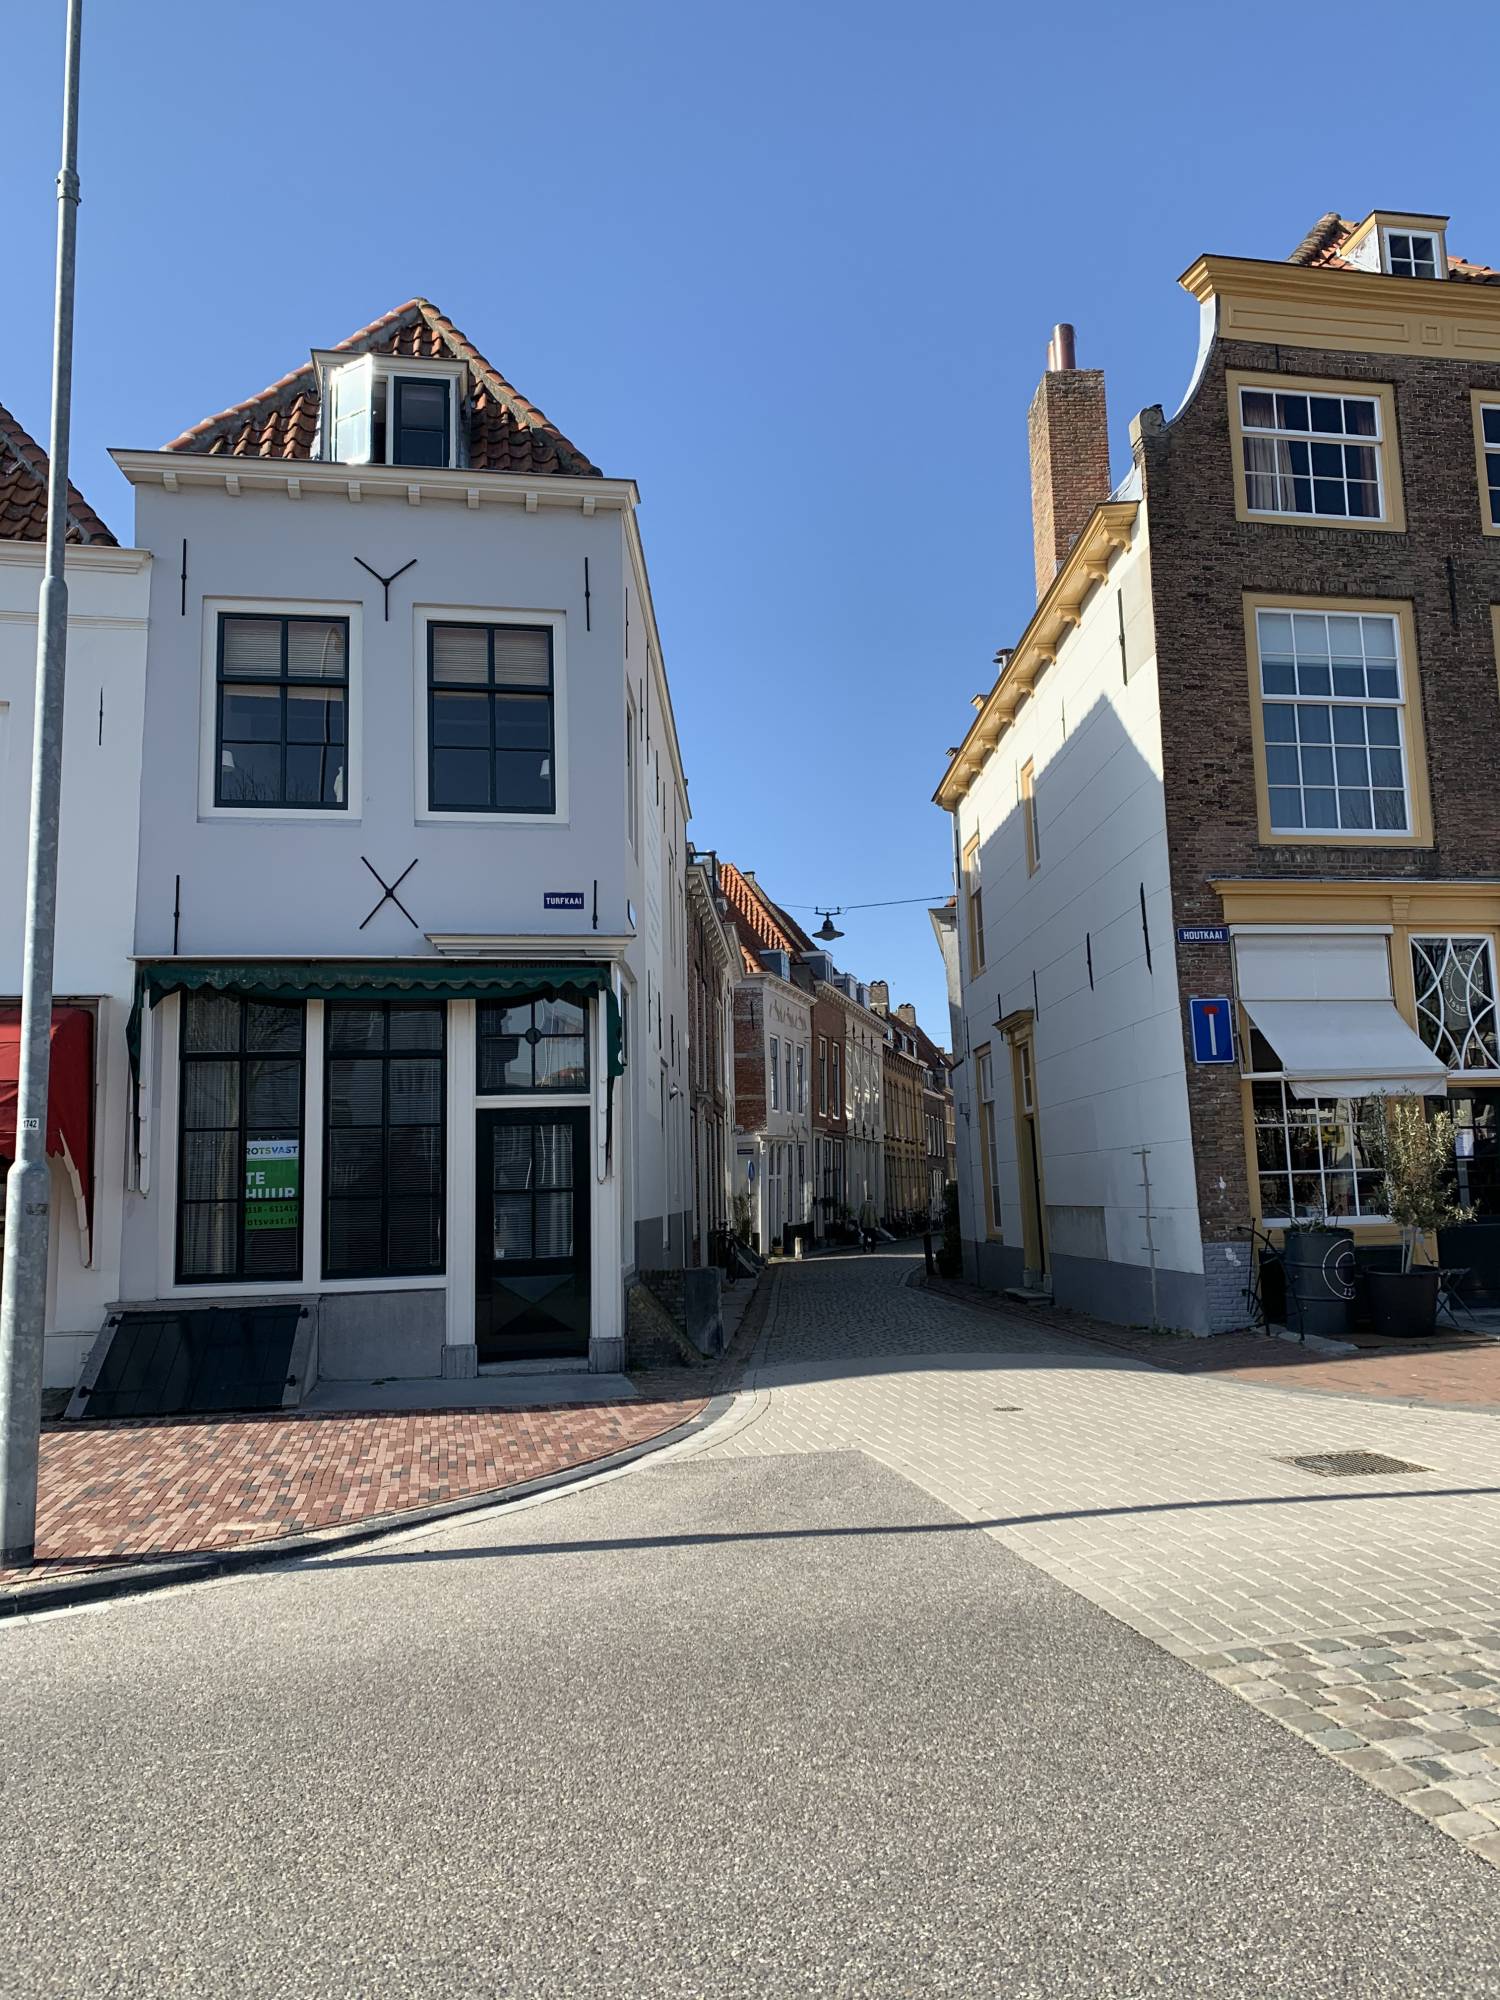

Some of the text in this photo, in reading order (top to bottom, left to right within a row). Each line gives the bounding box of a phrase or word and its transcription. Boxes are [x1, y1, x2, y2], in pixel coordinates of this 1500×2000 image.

[546, 897, 582, 905] TURFKAAI
[1183, 931, 1223, 940] HOUTKAAI
[23, 1120, 37, 1128] 1742
[246, 1172, 265, 1185] TE
[245, 1187, 296, 1199] HUUR
[246, 1216, 298, 1226] otsvast.nl
